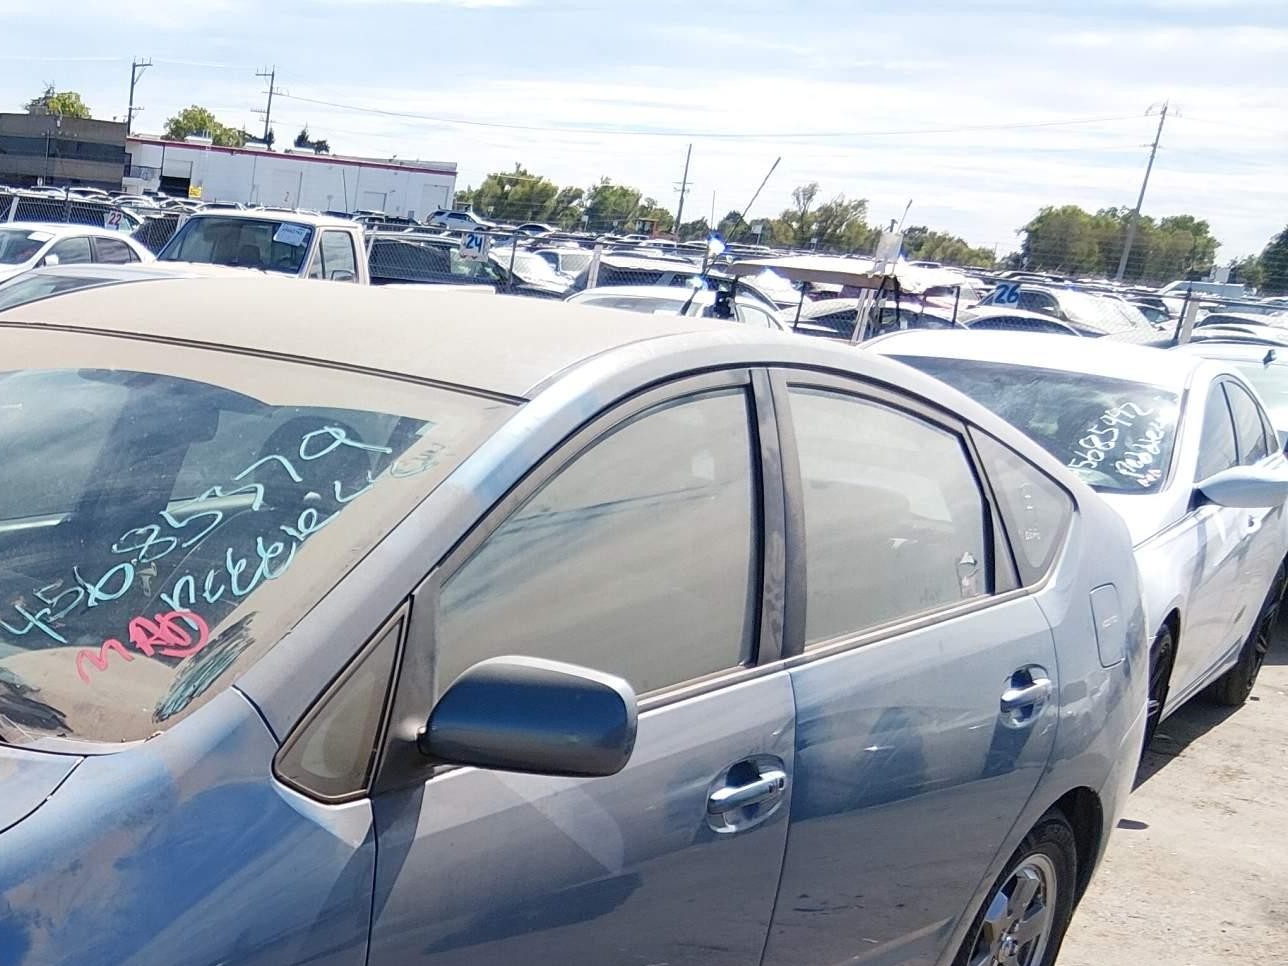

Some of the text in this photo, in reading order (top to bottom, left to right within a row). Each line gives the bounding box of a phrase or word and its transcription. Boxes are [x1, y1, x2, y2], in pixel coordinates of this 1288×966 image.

[108, 212, 122, 226] 22
[466, 234, 483, 253] 24
[994, 284, 1021, 304] 26
